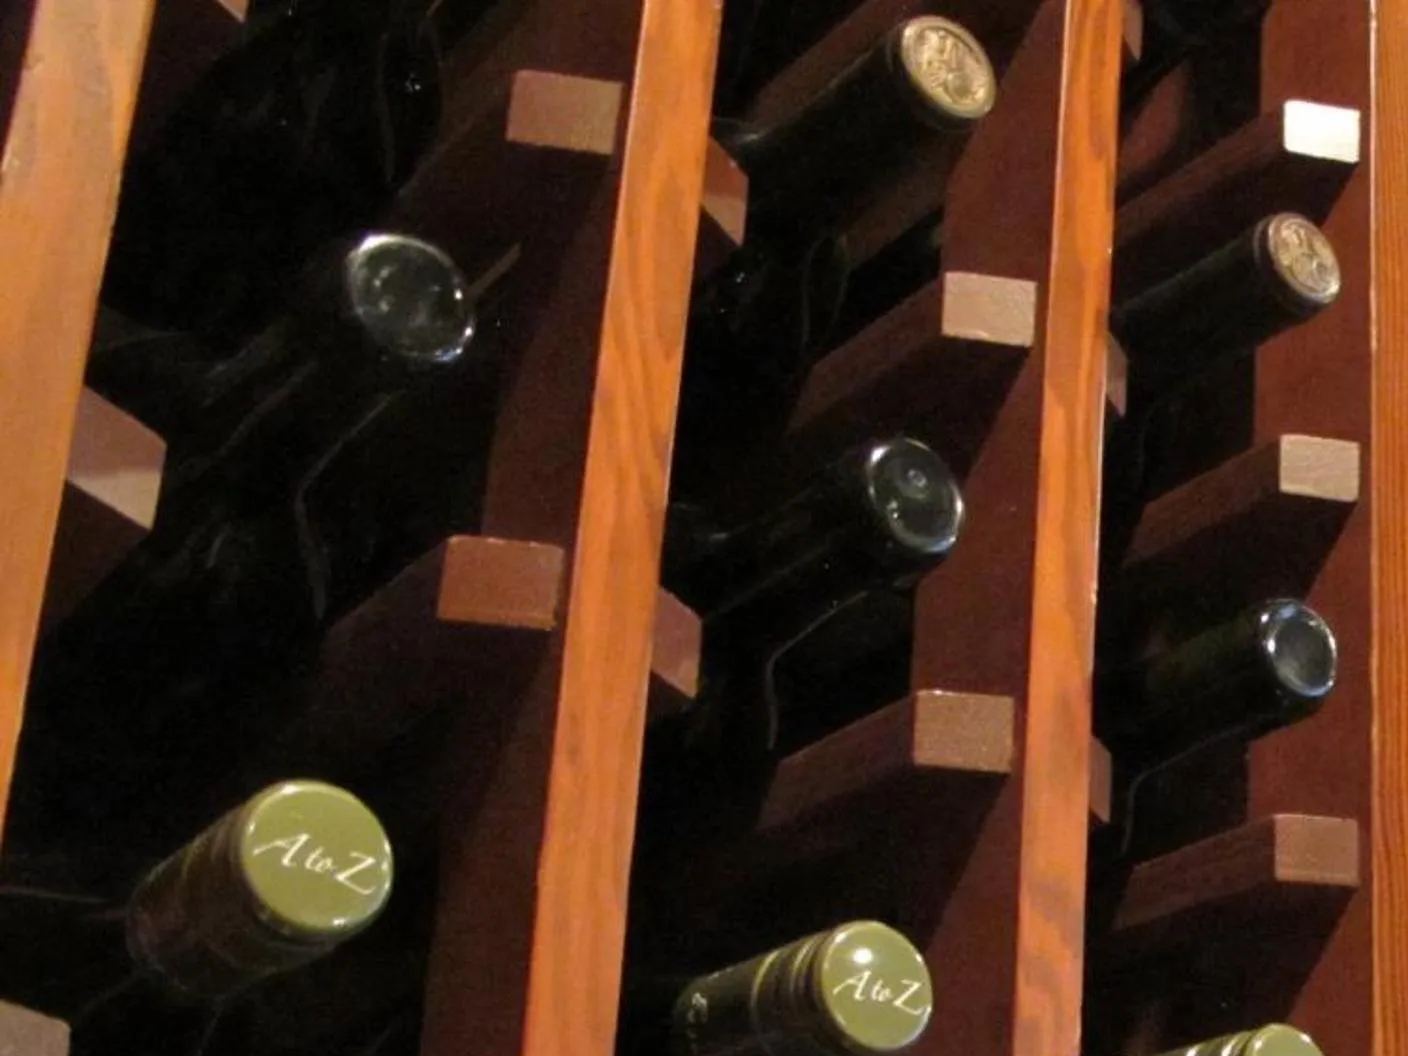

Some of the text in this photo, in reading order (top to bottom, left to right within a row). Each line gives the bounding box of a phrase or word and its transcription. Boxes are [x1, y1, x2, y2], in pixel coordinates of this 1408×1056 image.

[252, 833, 377, 895] A to Z
[833, 969, 928, 1016] A to Z
